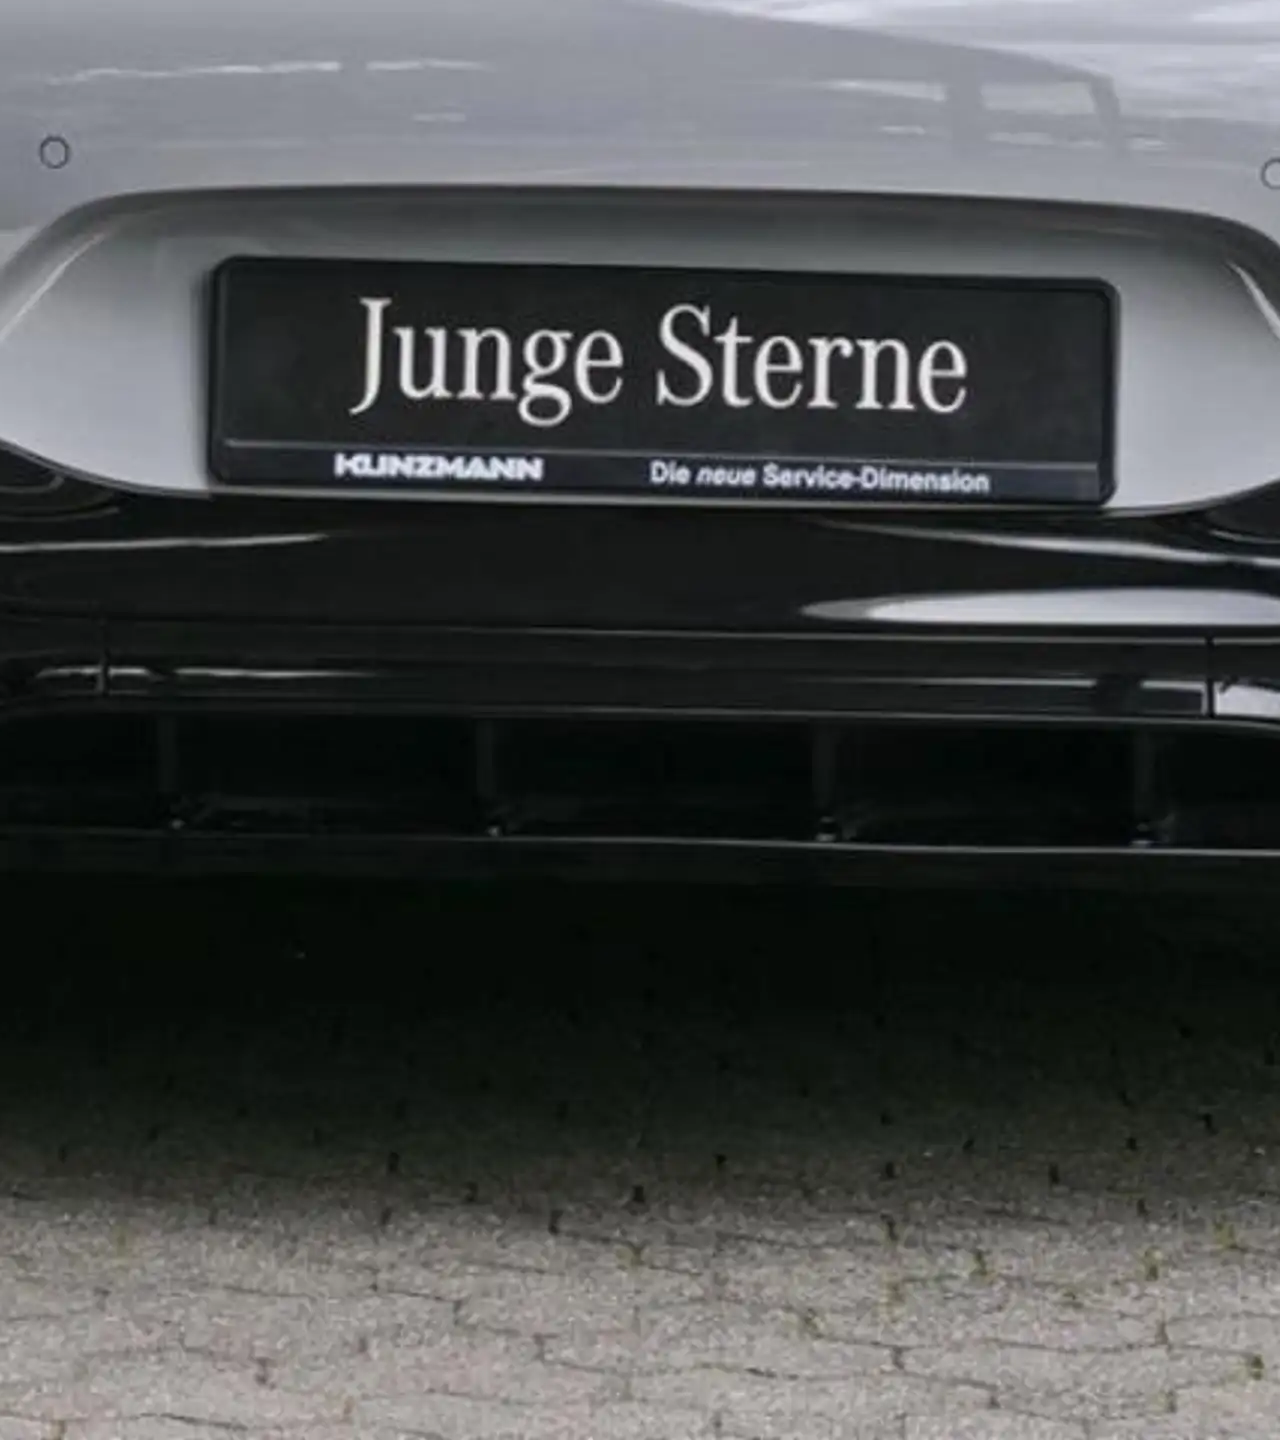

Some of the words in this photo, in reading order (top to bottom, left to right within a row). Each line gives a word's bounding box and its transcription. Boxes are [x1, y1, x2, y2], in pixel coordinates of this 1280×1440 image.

[348, 297, 624, 427] Junge
[656, 303, 968, 414] Sterne
[333, 452, 544, 481] KUNZMANN
[650, 459, 691, 485] Die
[695, 463, 757, 486] neue
[762, 462, 990, 493] Service-Dimension
